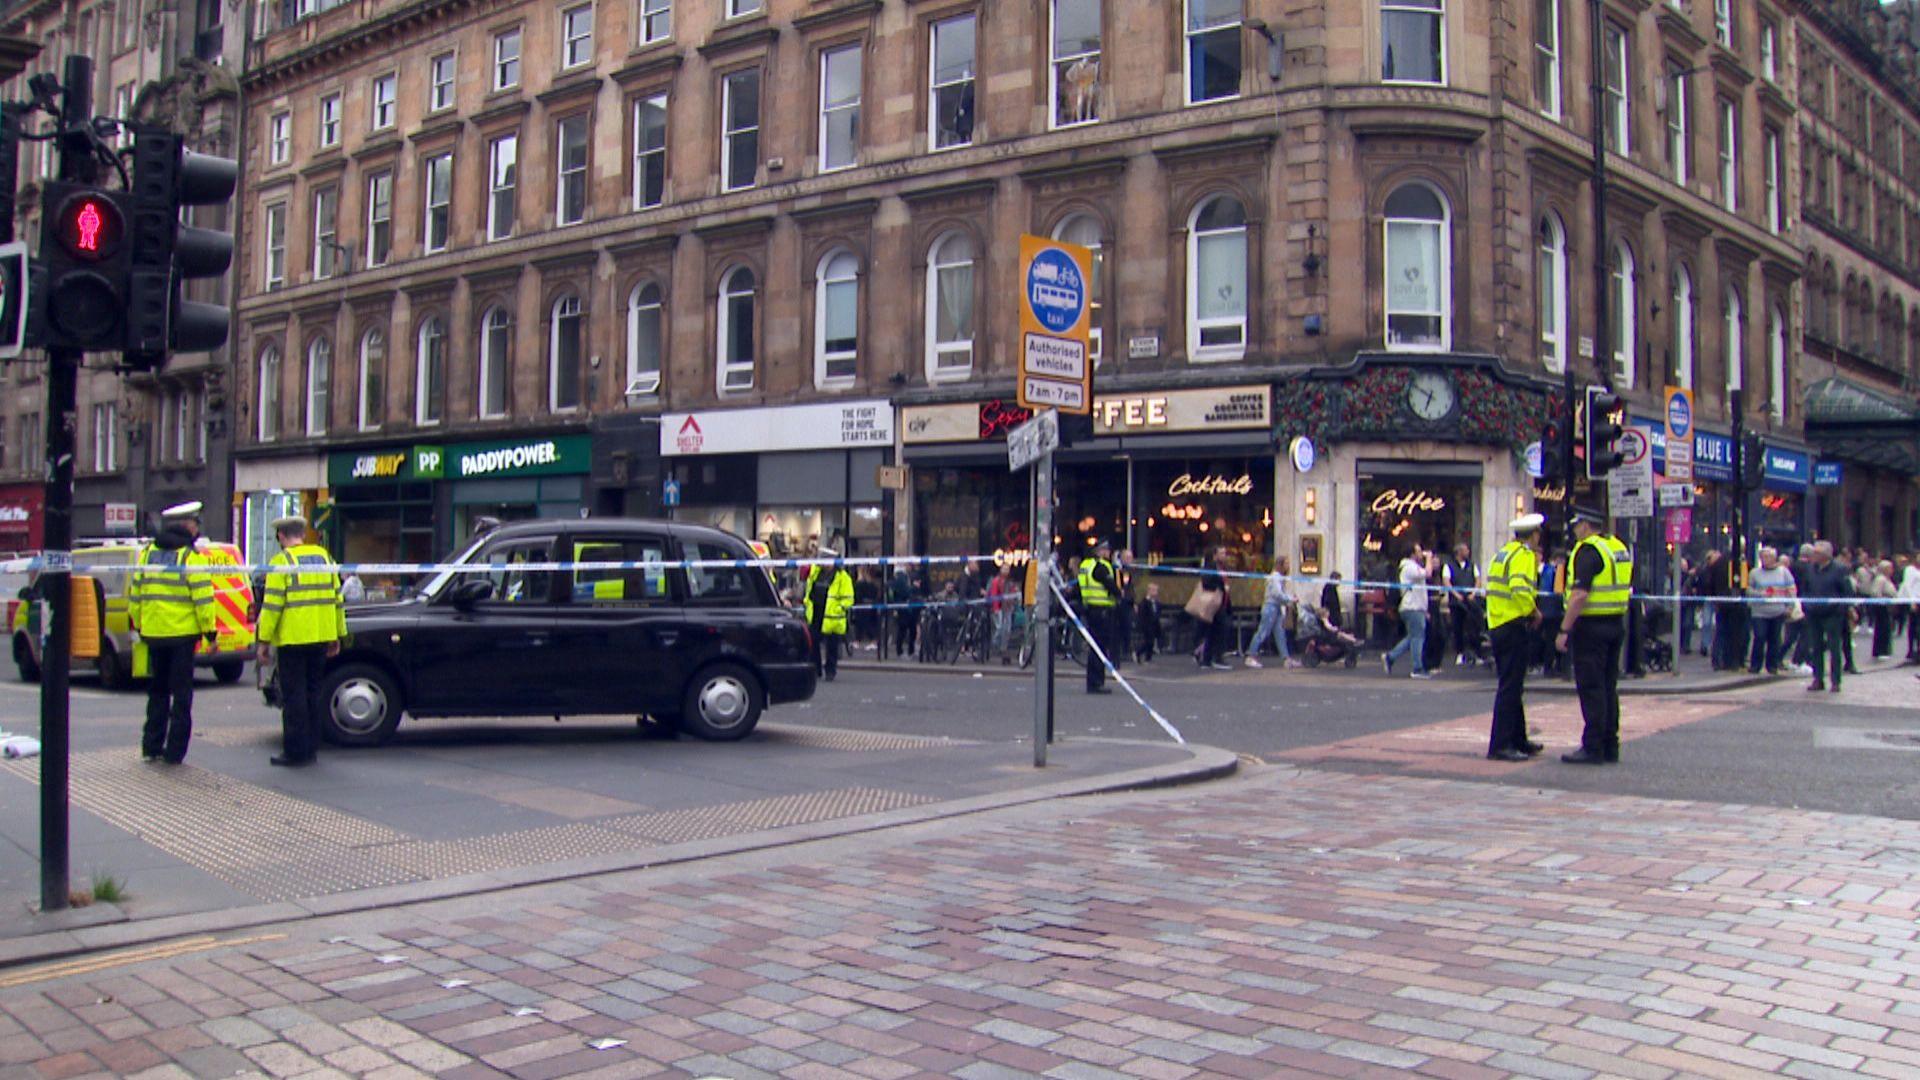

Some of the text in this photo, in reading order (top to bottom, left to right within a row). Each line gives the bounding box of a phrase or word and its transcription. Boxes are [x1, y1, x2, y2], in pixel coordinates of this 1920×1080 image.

[1046, 311, 1064, 325] taxi
[1029, 340, 1080, 359] Authorised
[1035, 356, 1073, 372] vehicles
[1230, 394, 1264, 403] COFFEE
[842, 407, 877, 419] THE FIGHT
[1092, 398, 1168, 427] FFEE
[1214, 403, 1264, 413] COCKTAILS
[841, 419, 875, 430] FOR HOME
[980, 400, 1031, 437] Sexy
[1204, 412, 1264, 422] SANDWICHES
[677, 434, 704, 447] SHELTER
[841, 430, 888, 442] STARTS HERE
[1696, 437, 1722, 463] BLUE
[353, 454, 404, 477] SUBWAY
[1168, 473, 1253, 496] Cocktails
[1372, 489, 1446, 515] Coffee
